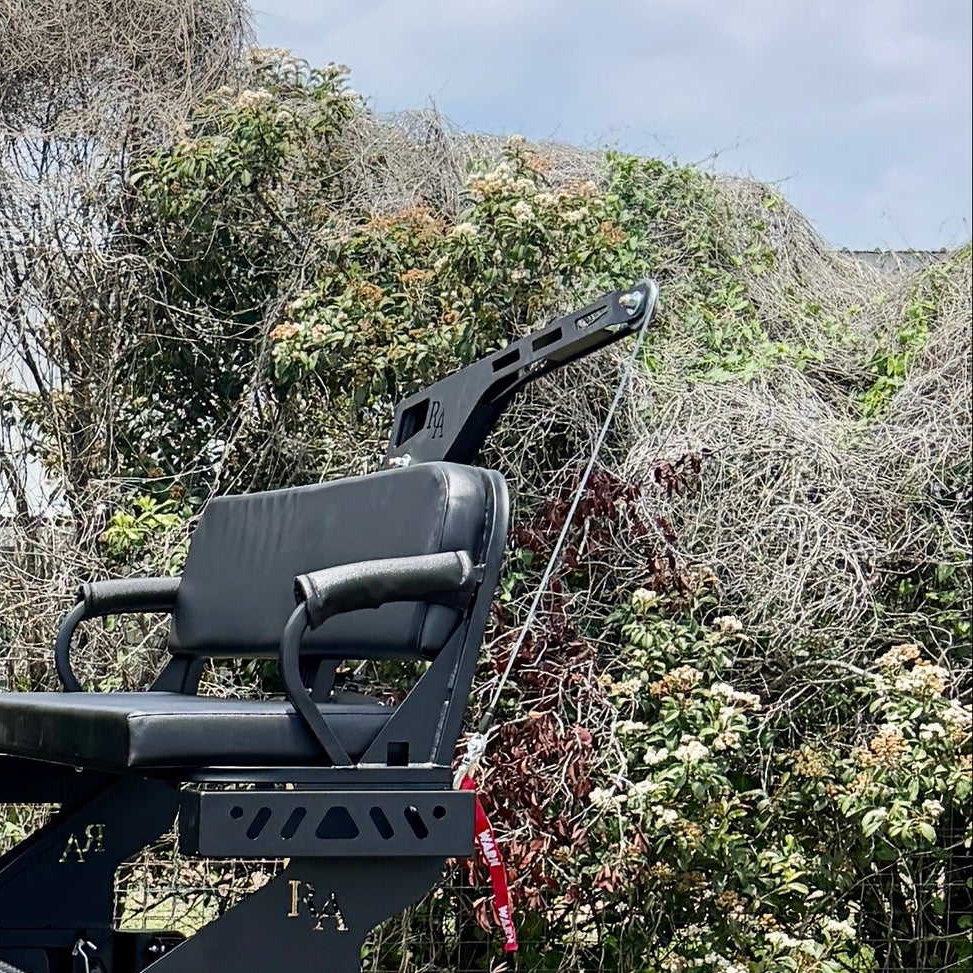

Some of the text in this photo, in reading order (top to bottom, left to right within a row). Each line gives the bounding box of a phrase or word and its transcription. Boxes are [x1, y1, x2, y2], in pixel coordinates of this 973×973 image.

[426, 401, 445, 439] RA
[478, 828, 501, 867] WARN
[288, 880, 349, 931] RA
[498, 905, 516, 944] WARN
